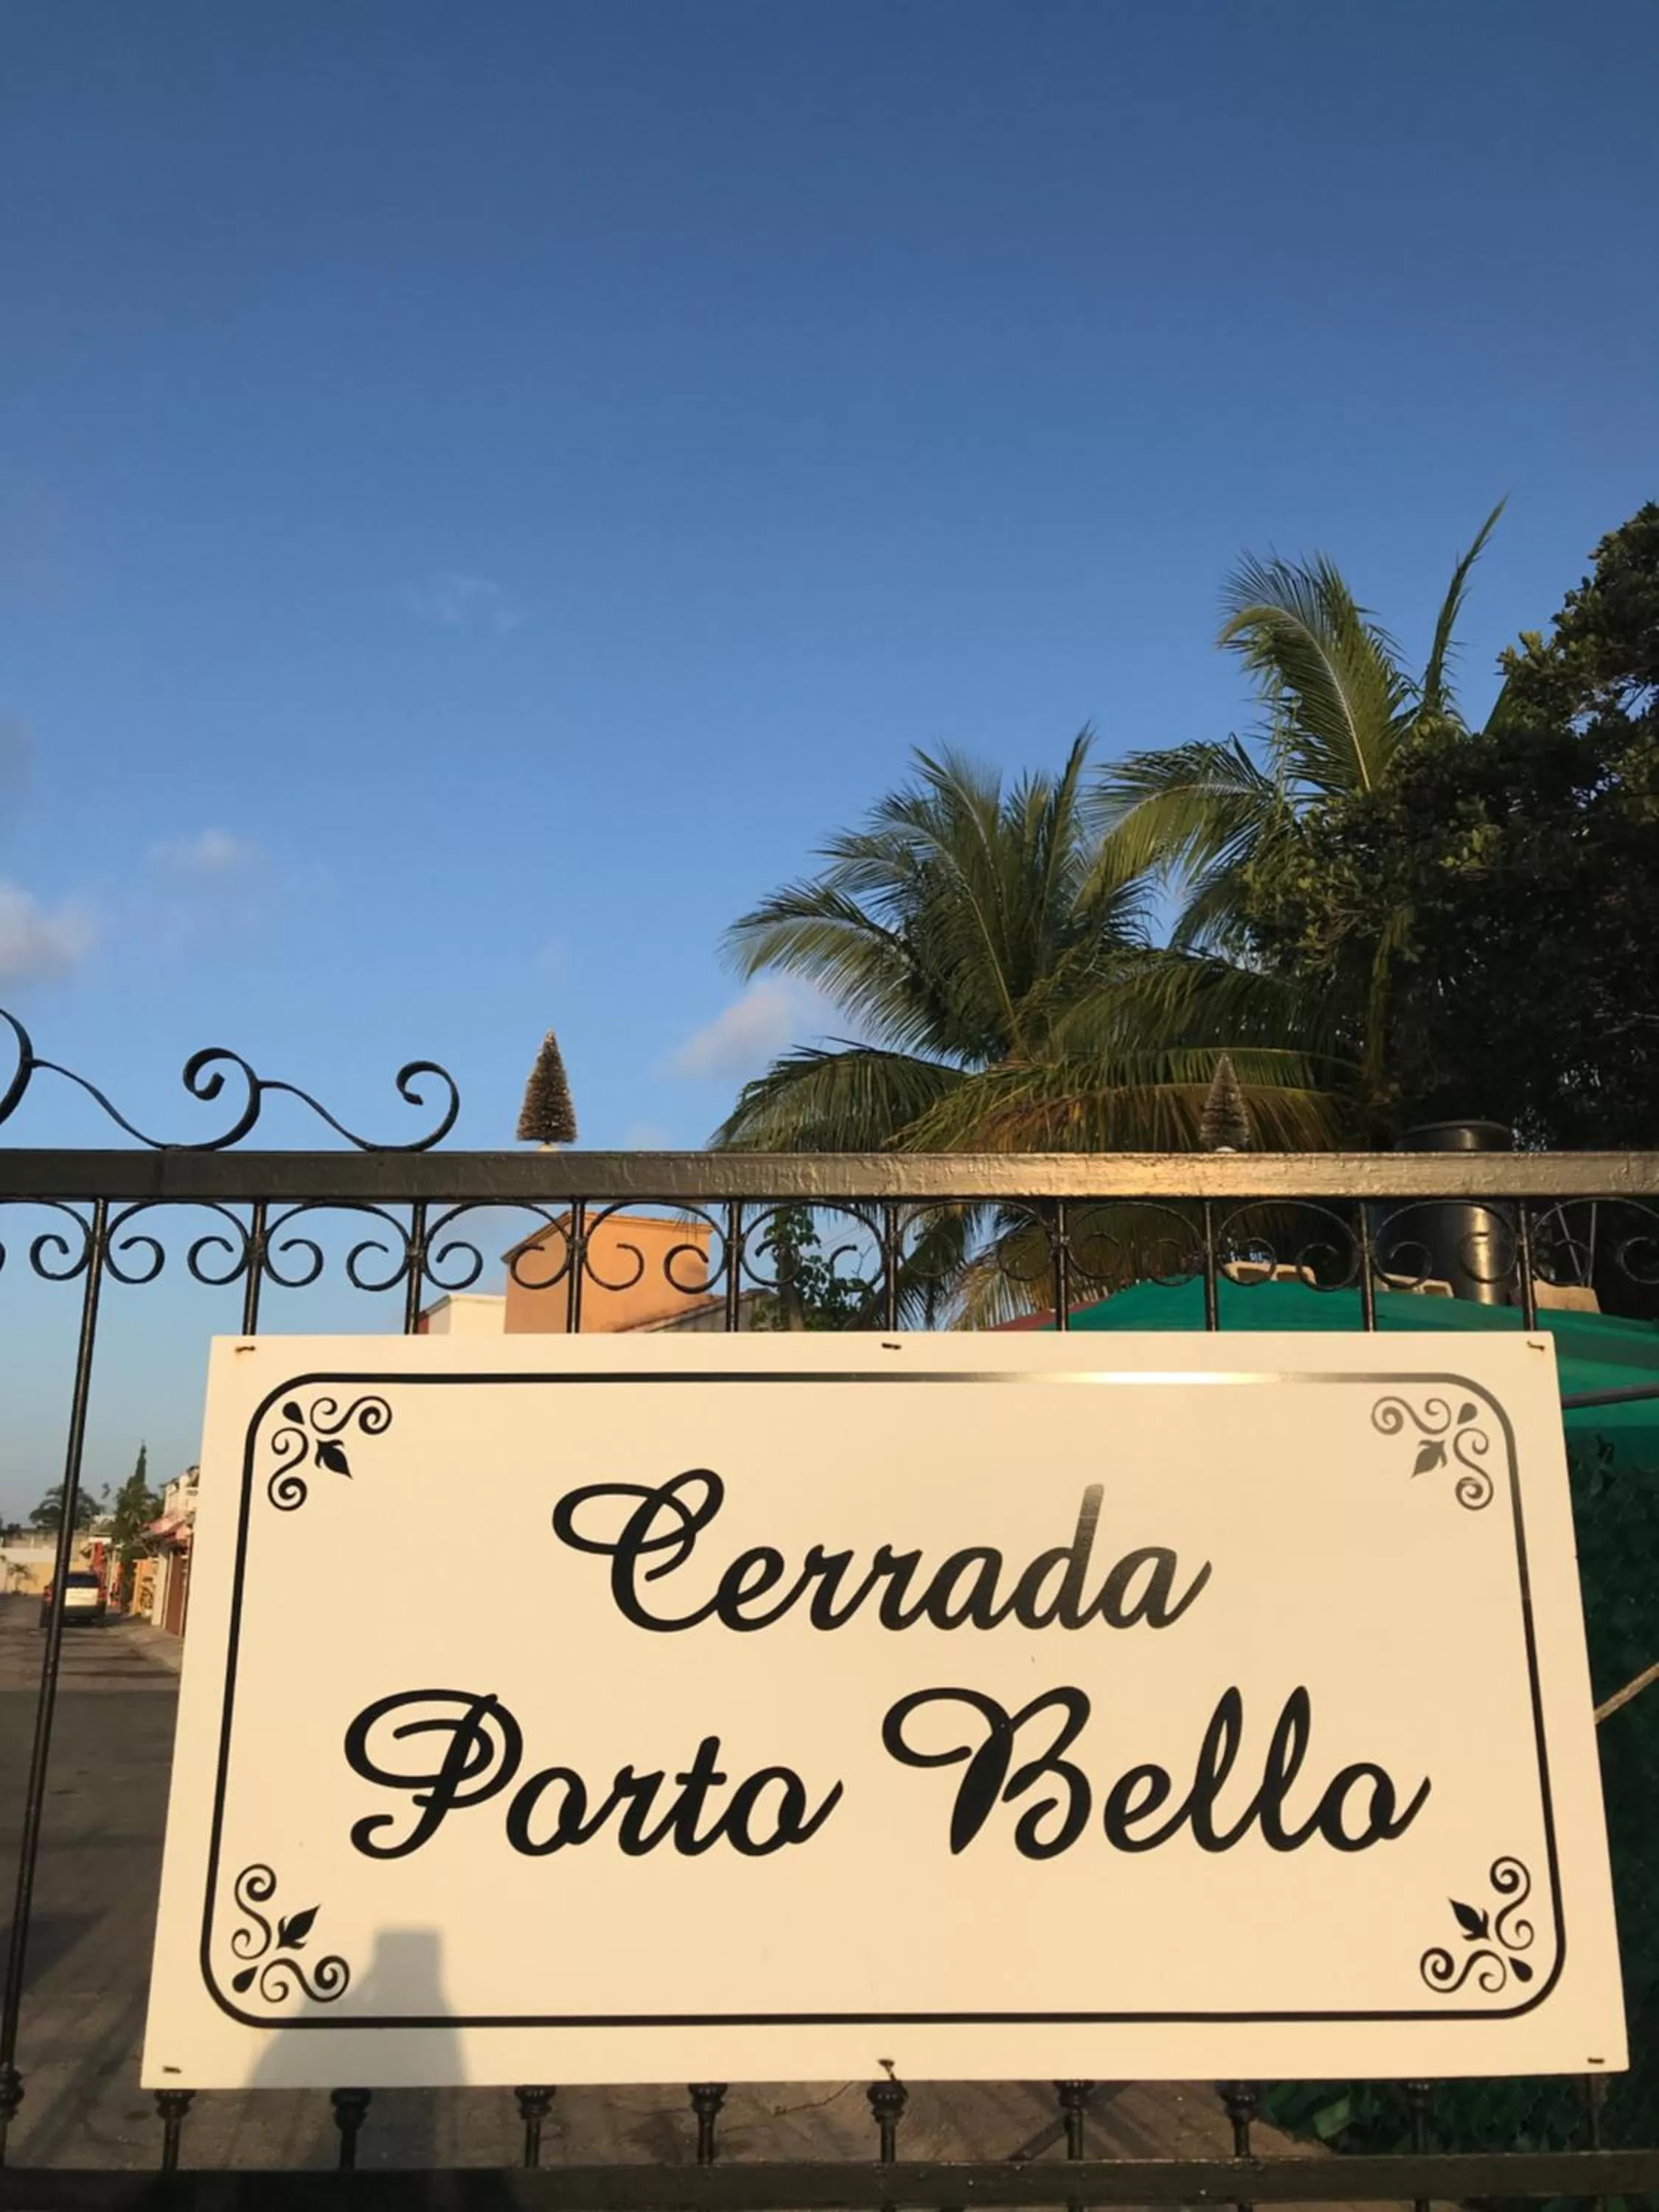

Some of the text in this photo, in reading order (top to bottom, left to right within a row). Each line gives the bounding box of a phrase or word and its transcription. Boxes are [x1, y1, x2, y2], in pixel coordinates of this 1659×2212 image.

[552, 1468, 1212, 1633] Cerrada
[344, 1685, 1431, 1861] Porto Bello
